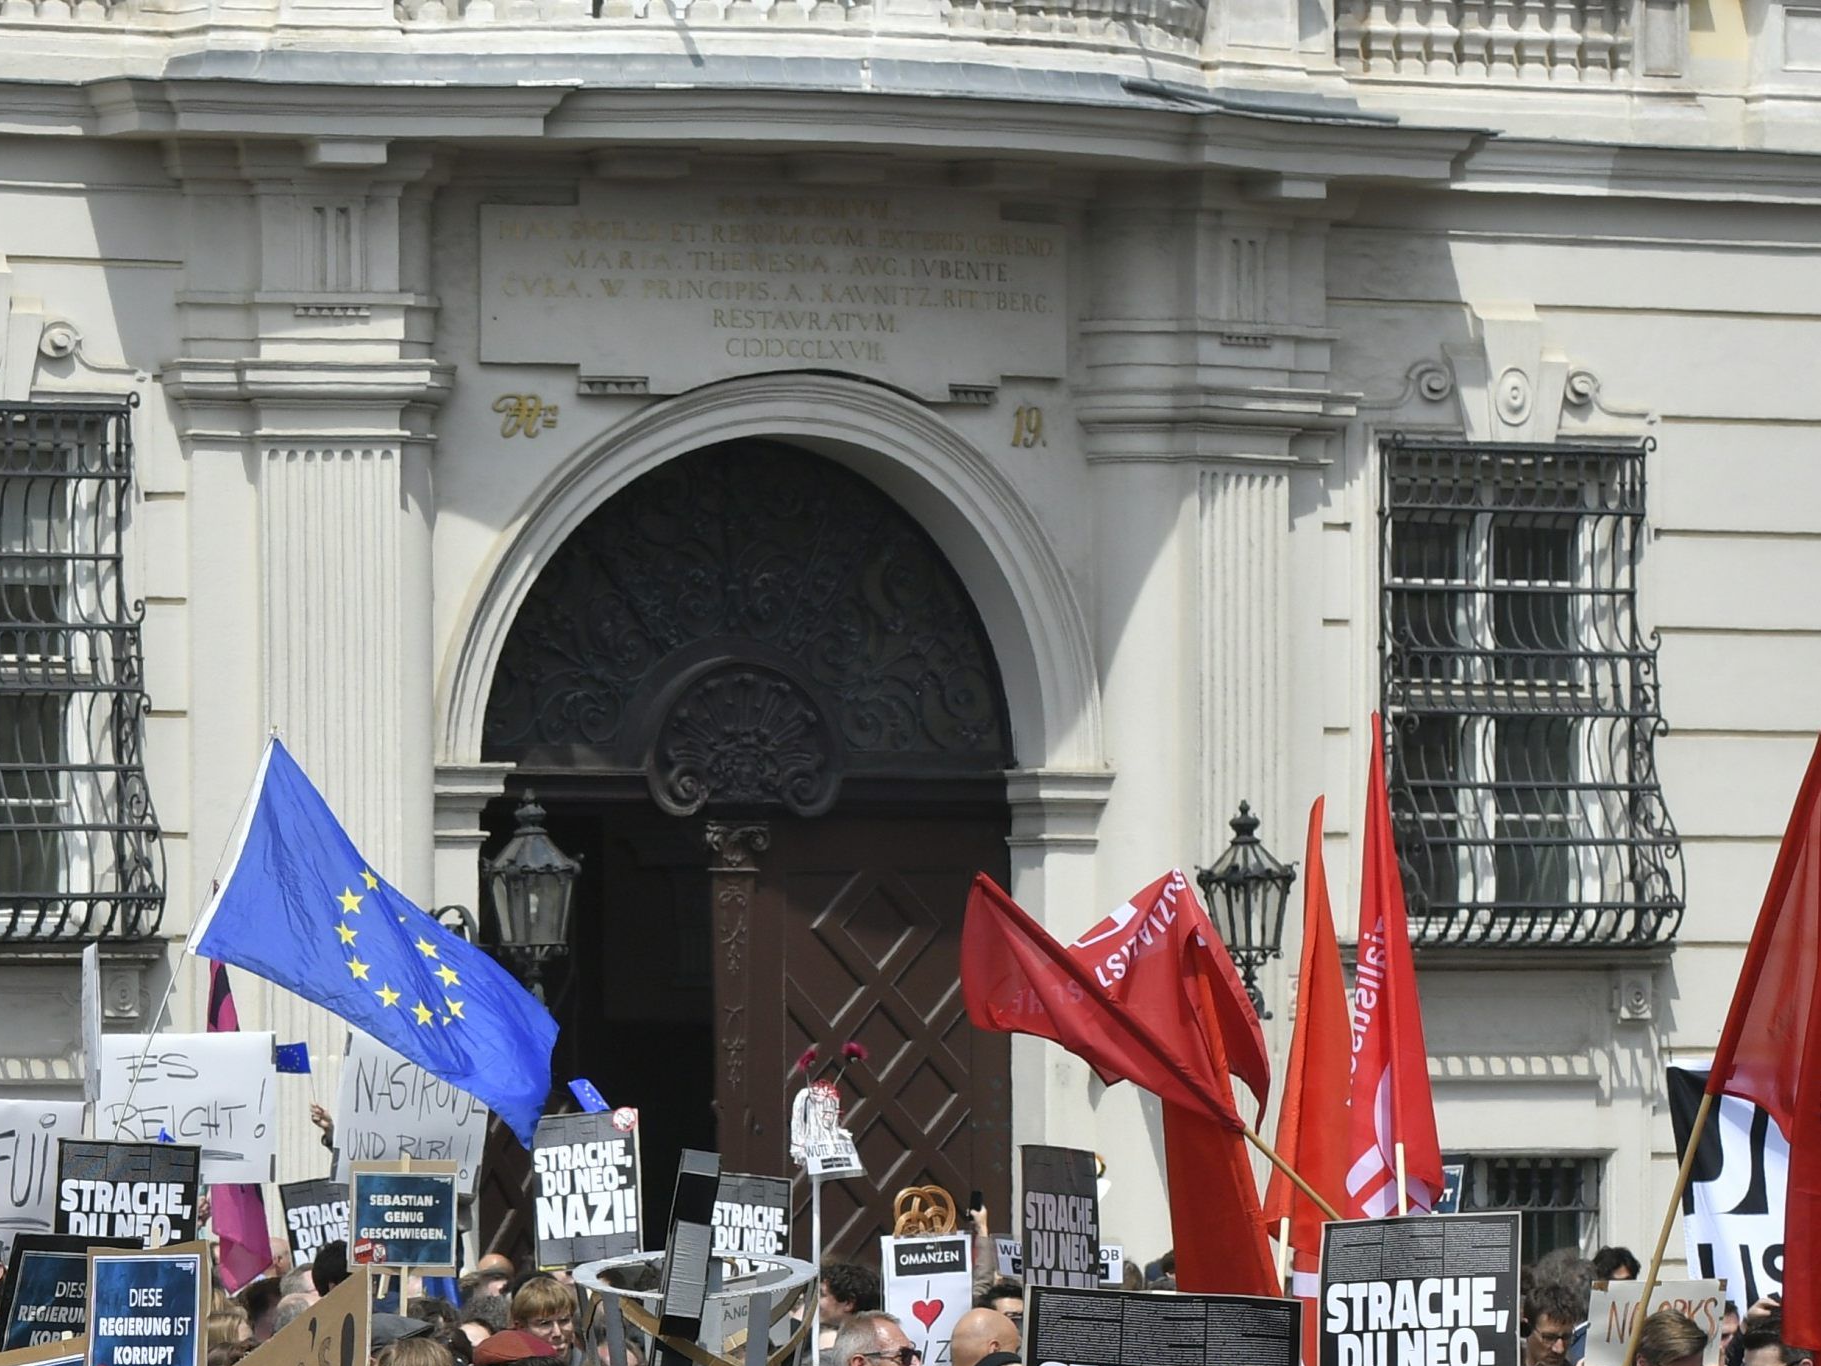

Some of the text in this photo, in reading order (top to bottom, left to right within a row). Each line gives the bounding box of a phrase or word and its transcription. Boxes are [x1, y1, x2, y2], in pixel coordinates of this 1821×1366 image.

[117, 1052, 198, 1083] ES
[348, 1128, 386, 1161] UND
[534, 1139, 632, 1173] STRACHE,
[541, 1165, 627, 1197] DU NEO-
[60, 1179, 192, 1219] STRACHE,
[369, 1194, 433, 1206] SEBASTIAN
[385, 1211, 424, 1223] GENUG
[536, 1189, 637, 1241] NAZI!
[711, 1201, 788, 1236] STRACHE,
[1026, 1191, 1097, 1240] STRACHE,
[296, 1222, 349, 1250] DU NE
[360, 1227, 447, 1241] GESCHWIEGEN.
[715, 1225, 783, 1254] DU NEO-
[900, 1250, 960, 1266] OMANZEN
[1032, 1230, 1094, 1272] DU NEO-
[1100, 1248, 1119, 1261] OB
[55, 1282, 87, 1298] DIES
[129, 1288, 163, 1308] DIESE
[18, 1305, 86, 1323] REGIERUN
[1326, 1277, 1509, 1333] STRACHE,
[99, 1316, 191, 1337] REGIERUNG IST
[113, 1346, 174, 1365] KORRUPT
